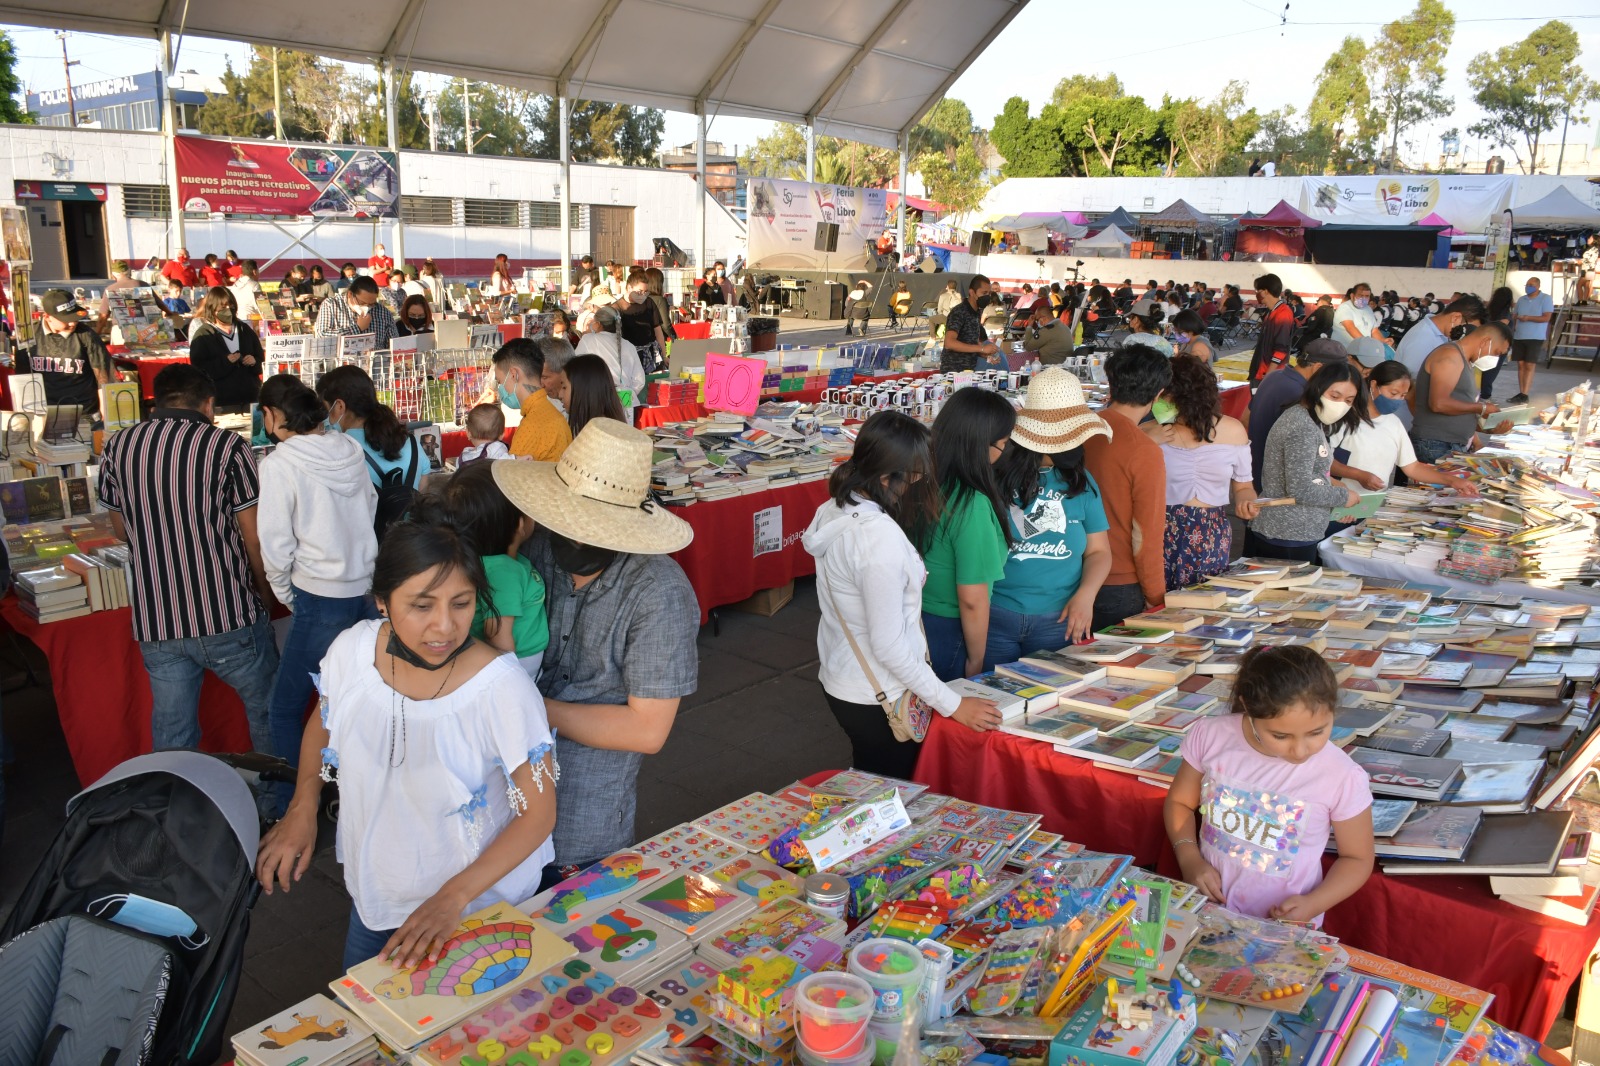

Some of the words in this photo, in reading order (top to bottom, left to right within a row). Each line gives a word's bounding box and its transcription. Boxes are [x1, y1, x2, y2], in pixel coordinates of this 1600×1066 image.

[82, 76, 138, 99] MUNICIPAL
[225, 170, 272, 179] Inauguramos
[181, 176, 219, 185] nuevos
[221, 178, 260, 188] parques
[261, 180, 311, 190] recreativos
[1406, 184, 1429, 193] Feria
[219, 187, 251, 196] disfrutar
[252, 189, 272, 197] todas
[279, 190, 298, 198] todos
[836, 187, 855, 197] Feria
[1404, 200, 1429, 208] Libro
[837, 206, 856, 217] Libro
[31, 356, 85, 374] HILLY
[707, 361, 753, 408] 50
